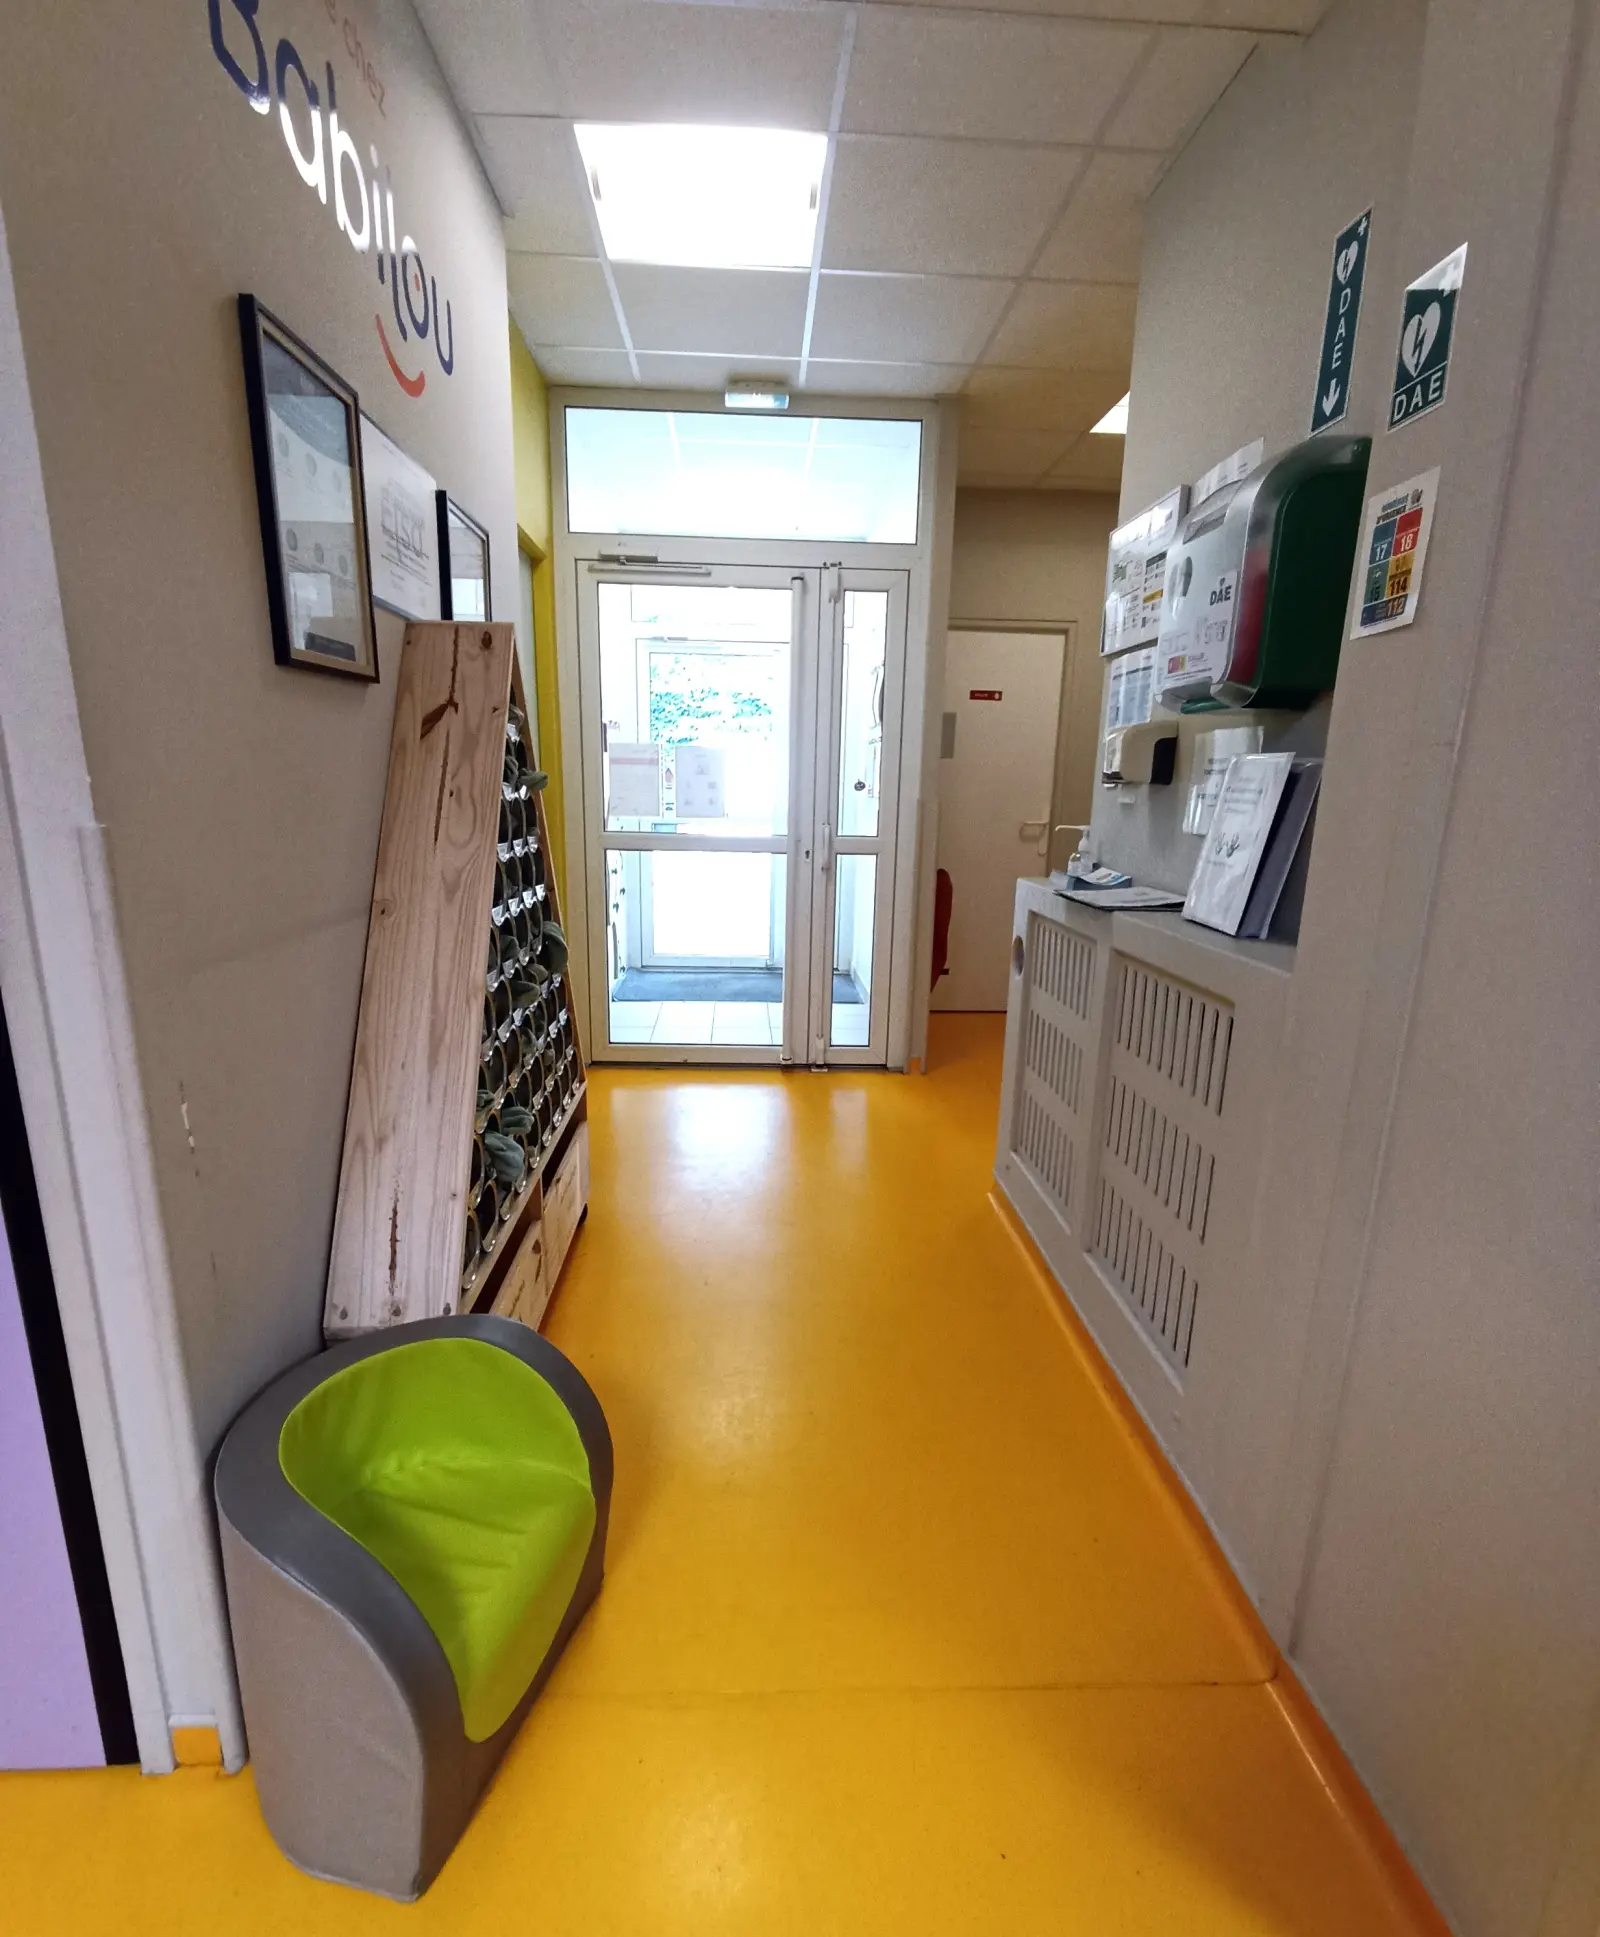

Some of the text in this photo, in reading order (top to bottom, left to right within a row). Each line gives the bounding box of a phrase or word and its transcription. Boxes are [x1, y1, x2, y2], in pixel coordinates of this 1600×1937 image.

[1331, 288, 1351, 370] DAE
[1392, 370, 1443, 423] DAE
[1375, 543, 1388, 561] 17
[1400, 533, 1414, 552] 18
[1209, 585, 1233, 606] DAE
[1389, 577, 1408, 597] 114
[1386, 597, 1406, 618] 112
